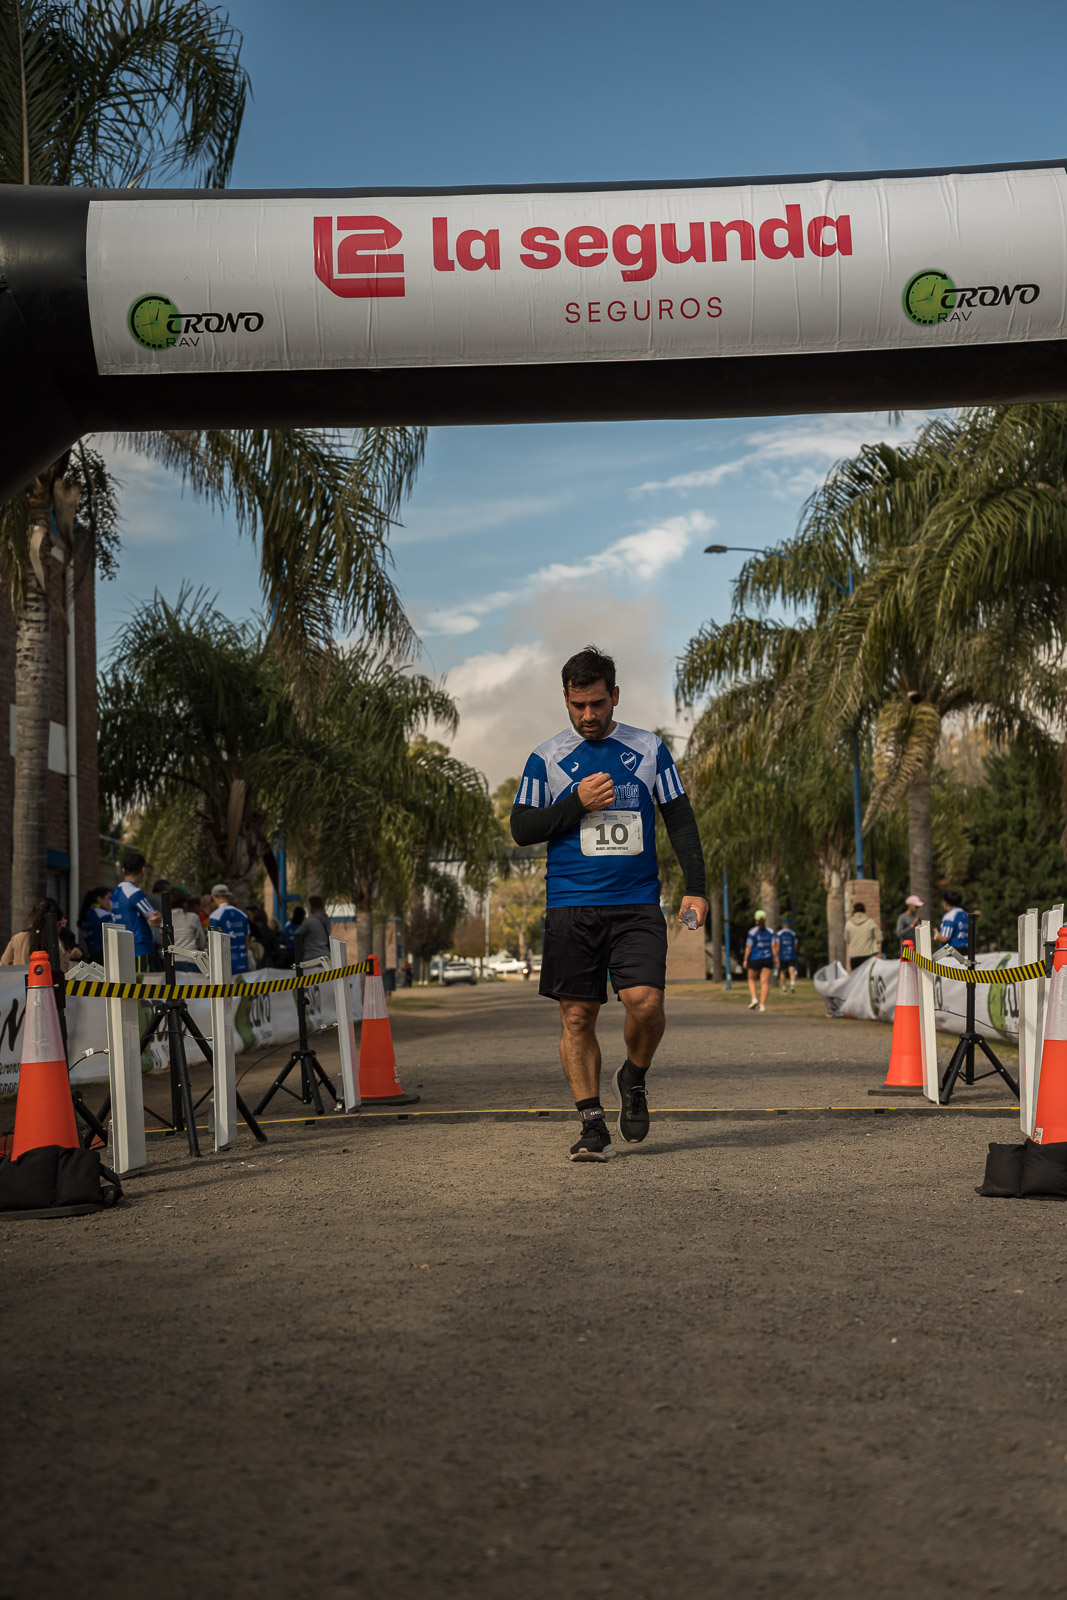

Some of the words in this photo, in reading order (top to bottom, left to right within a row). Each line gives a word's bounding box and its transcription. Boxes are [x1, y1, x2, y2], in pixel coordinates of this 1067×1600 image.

[432, 216, 501, 272] la
[519, 203, 853, 283] segunda
[564, 297, 723, 324] SEGUROS
[937, 312, 973, 323] RAV
[166, 336, 202, 348] RAV
[595, 823, 629, 845] 10
